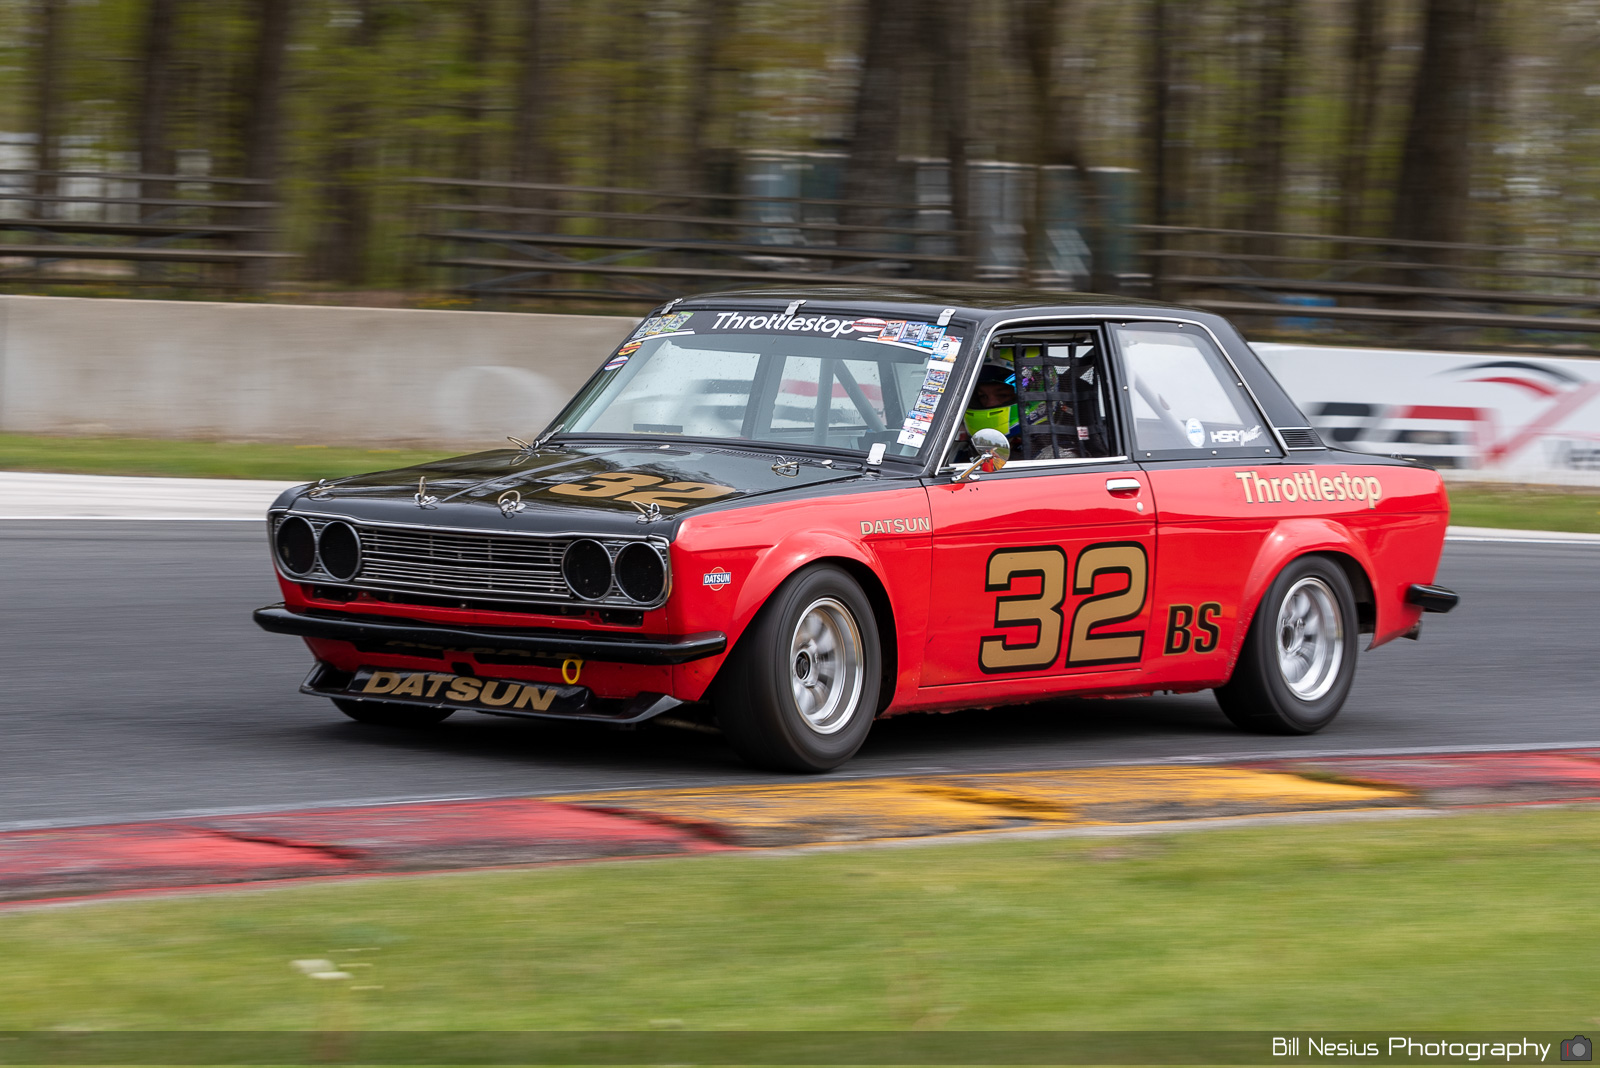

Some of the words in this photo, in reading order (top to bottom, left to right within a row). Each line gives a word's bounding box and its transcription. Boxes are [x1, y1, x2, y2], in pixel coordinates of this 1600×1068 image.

[711, 312, 855, 338] Throttlestop
[1209, 430, 1239, 443] HSR
[548, 472, 737, 509] 32
[1234, 469, 1383, 509] Throttlestop
[859, 516, 931, 536] DATSUN
[704, 572, 731, 585] DATSUN
[979, 540, 1149, 675] 32
[1163, 601, 1222, 656] BS
[361, 670, 558, 712] DATSUN
